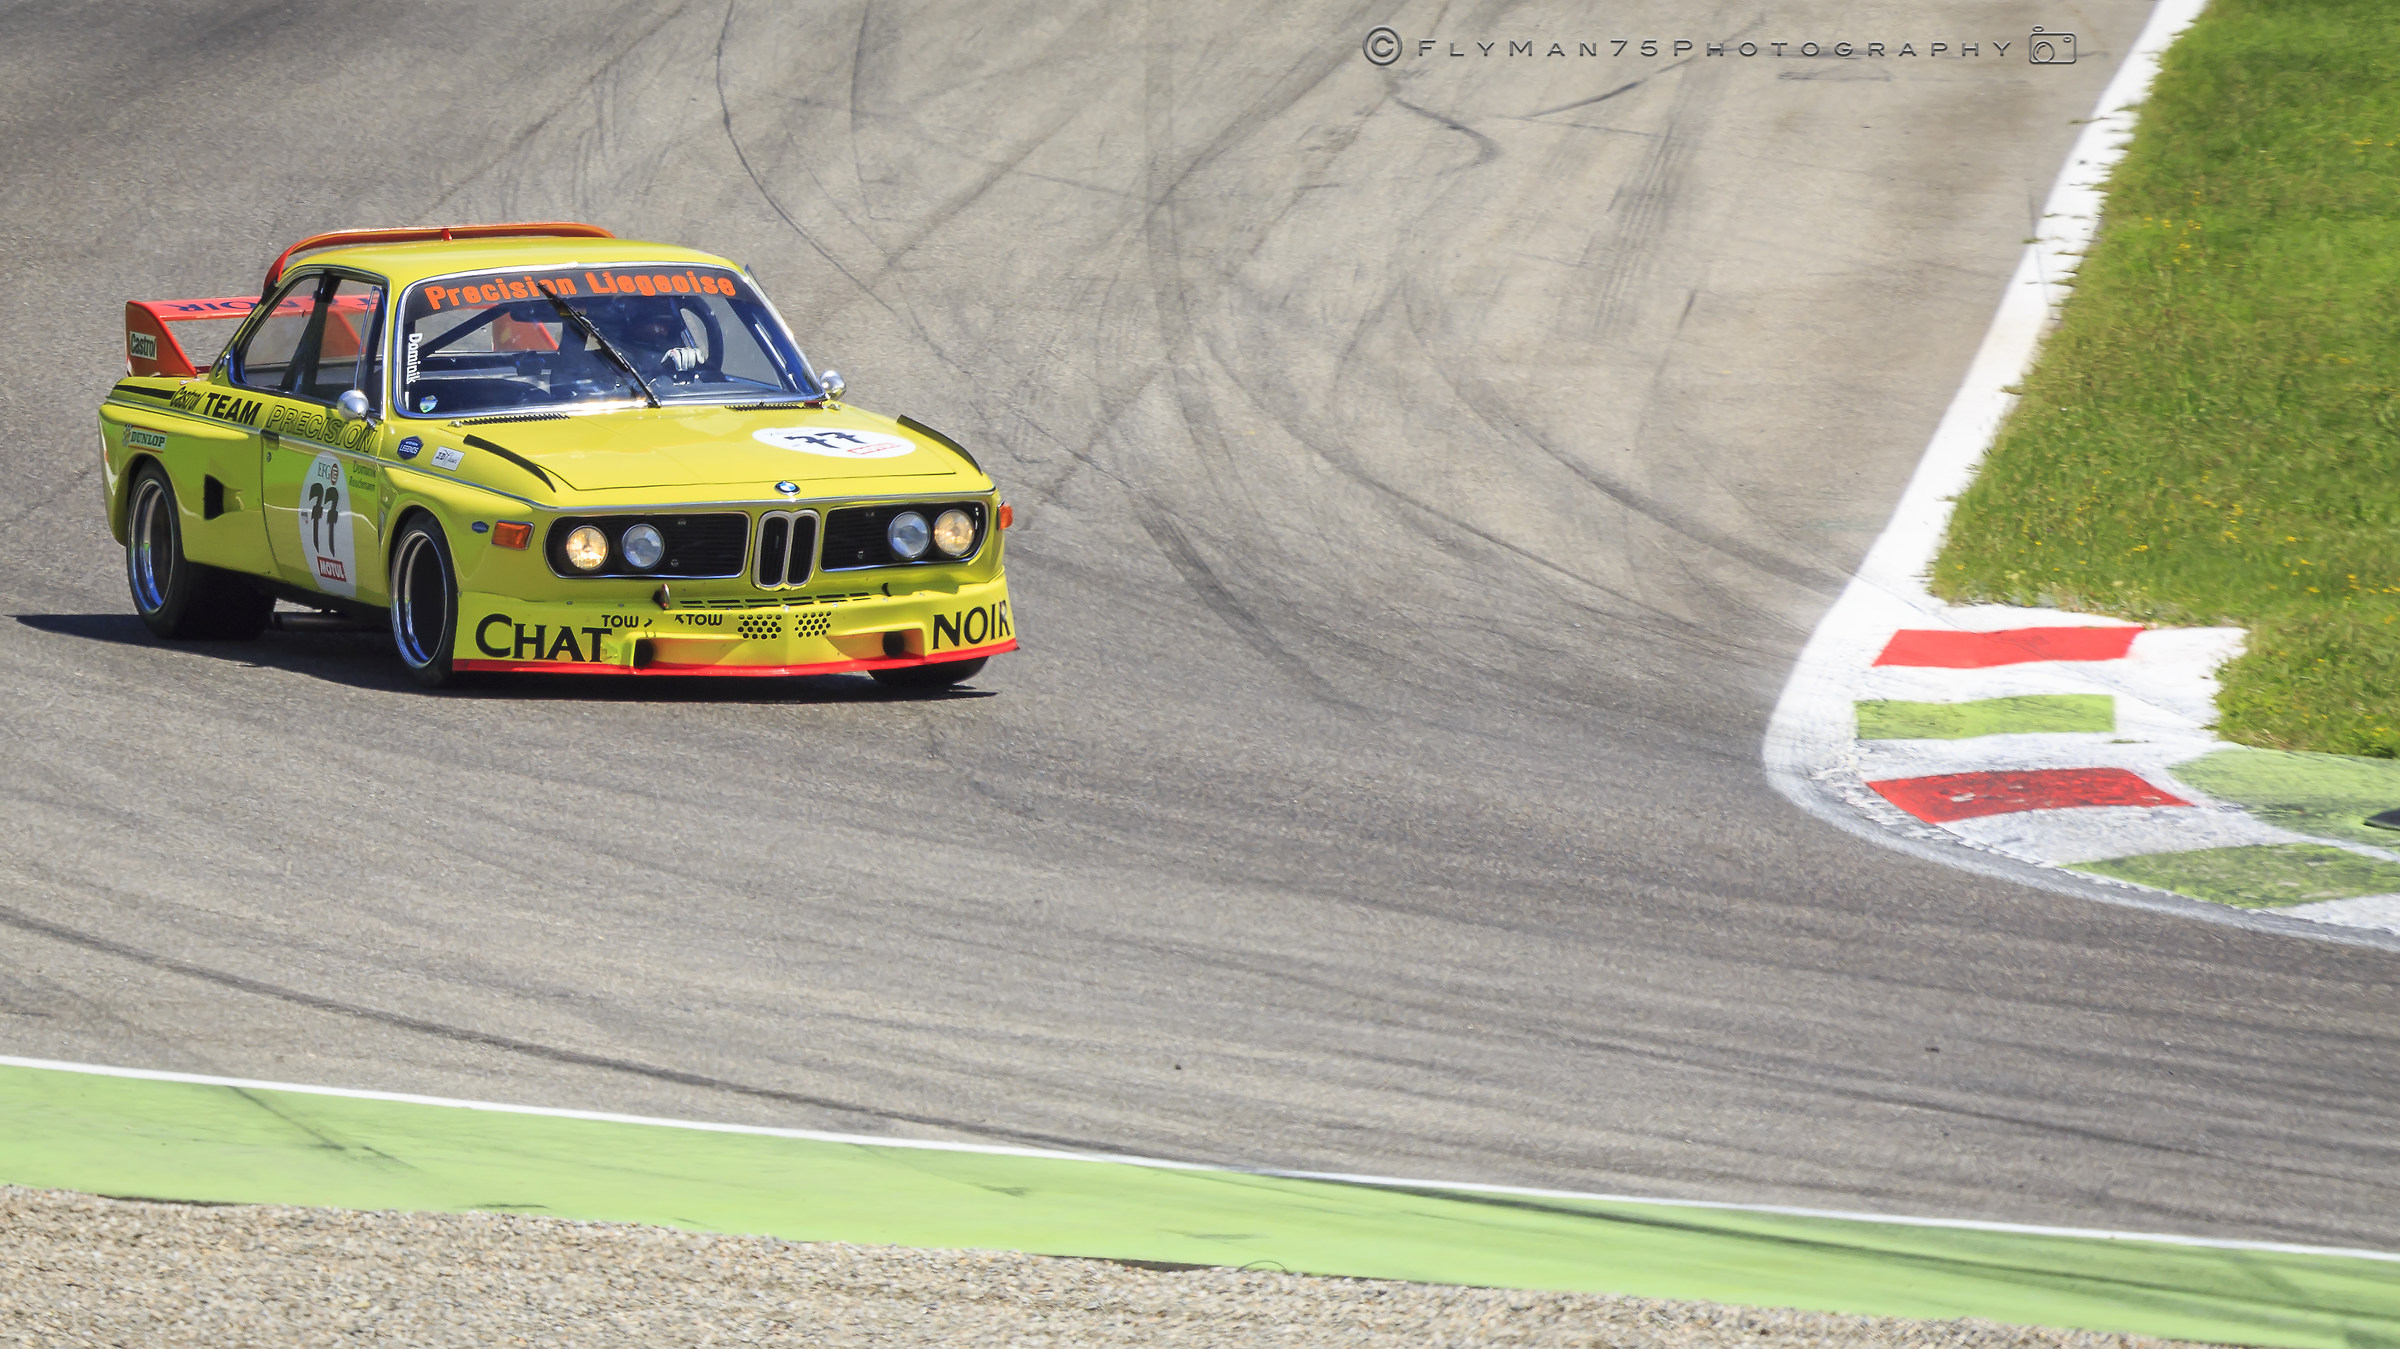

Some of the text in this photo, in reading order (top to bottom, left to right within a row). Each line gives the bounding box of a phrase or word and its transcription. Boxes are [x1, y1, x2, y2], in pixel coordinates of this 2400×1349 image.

[424, 270, 736, 311] Precision Liegeoise
[131, 333, 156, 358] Castrol
[406, 332, 423, 385] Dominik
[169, 386, 378, 453] Castrol TEAM PRECISION
[130, 431, 165, 447] DUNLOP
[309, 482, 339, 557] 77
[320, 560, 345, 579] MOTUL
[475, 600, 1011, 663] CHAT NOIR
[601, 615, 639, 628] TOW
[685, 614, 723, 626] TOW
